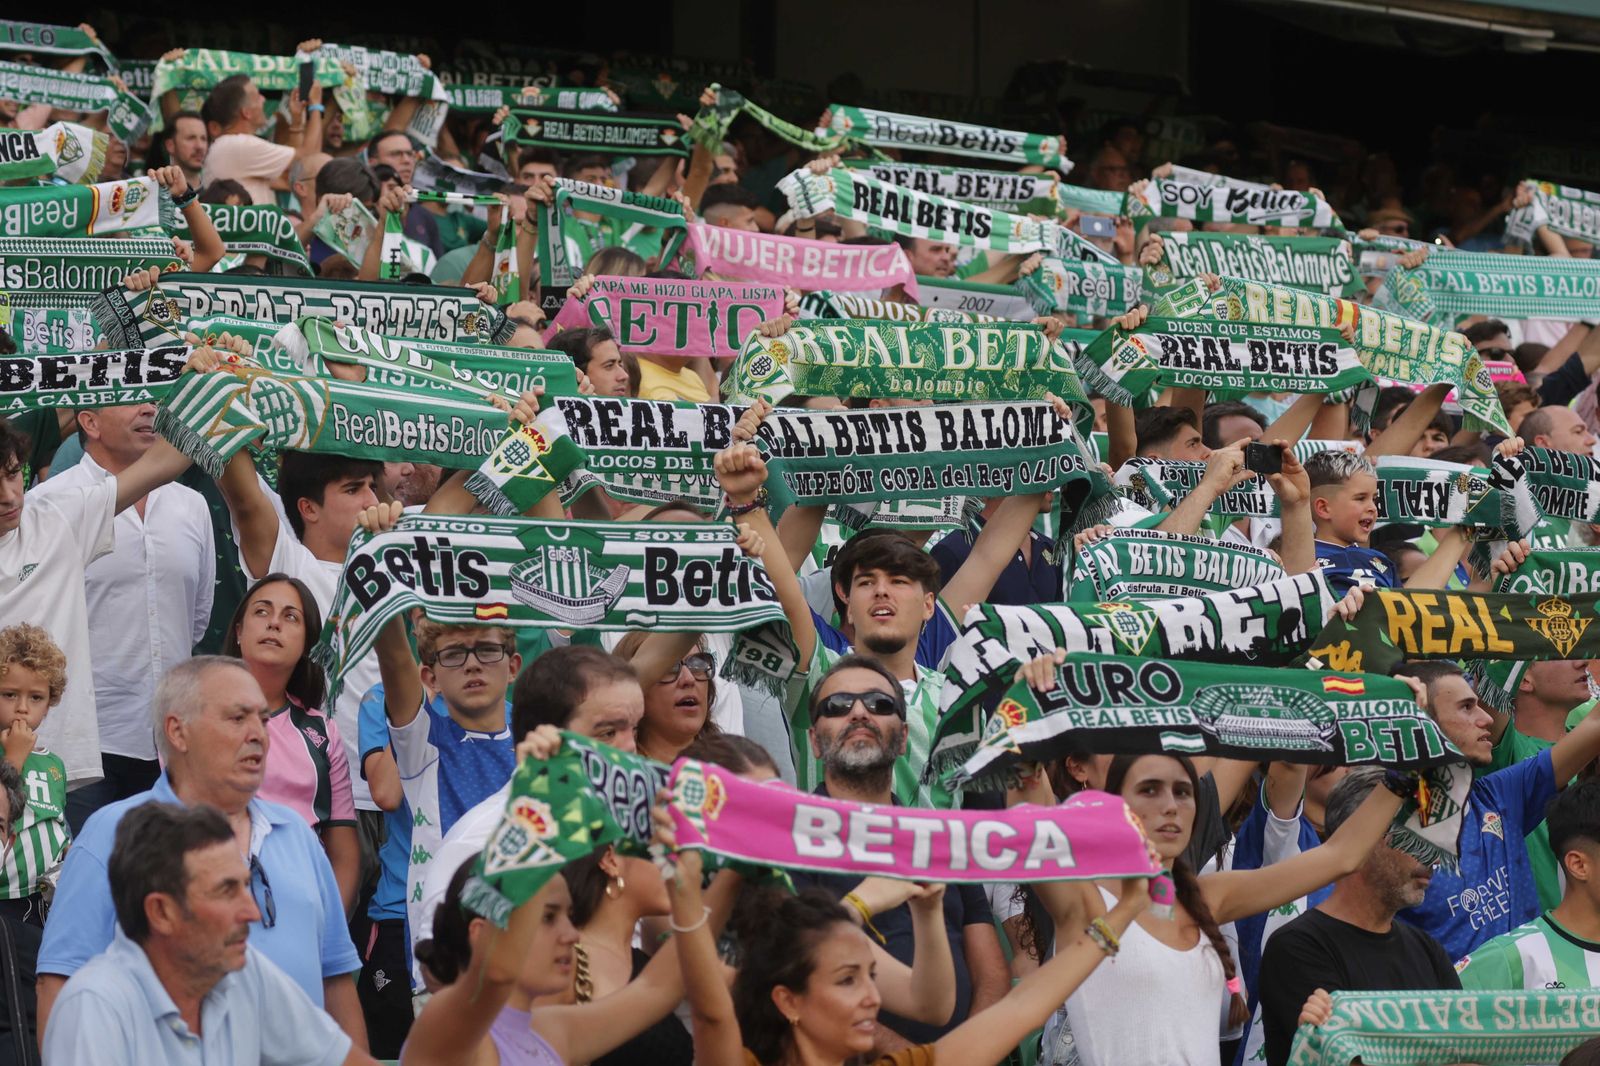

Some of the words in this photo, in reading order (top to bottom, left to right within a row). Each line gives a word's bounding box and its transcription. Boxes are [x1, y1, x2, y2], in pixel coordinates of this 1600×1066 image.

[544, 121, 570, 140] REAL
[573, 123, 603, 142] BETIS
[875, 115, 1018, 154] RealBetis
[955, 173, 1036, 200] BETIS
[1163, 183, 1213, 206] SOY
[630, 281, 649, 295] ME
[654, 284, 686, 297] HIZO
[743, 287, 778, 300] LISTA
[1067, 271, 1116, 301] Real
[1475, 272, 1537, 295] BETIS
[959, 295, 995, 313] 2007
[23, 311, 75, 348] Betis
[1167, 321, 1212, 333] DICEN
[1219, 323, 1248, 336] QUE
[1254, 325, 1321, 340] ESTAMOS
[1244, 282, 1331, 328] REAL
[1361, 309, 1466, 367] BETIS
[511, 352, 531, 360] BETIS
[788, 325, 925, 370] REAL
[1158, 334, 1242, 372] REAL
[1248, 339, 1339, 376] BETIS
[0, 346, 188, 392] BETIS
[1174, 373, 1223, 387] LOCOS
[1228, 376, 1246, 387] DE
[1250, 377, 1268, 388] LA
[1271, 378, 1329, 390] CABEZA
[37, 388, 154, 407] CABEZA
[557, 398, 691, 450] REAL
[758, 416, 828, 463] EAL
[825, 411, 927, 457] BETIS
[589, 453, 657, 470] LOCOS
[663, 456, 695, 471] DE
[702, 457, 715, 471] L
[1159, 465, 1190, 487] Rey
[881, 467, 938, 492] COPA
[941, 463, 972, 489] del
[976, 463, 1014, 492] Rey
[1221, 493, 1267, 514] FINAL
[1391, 479, 1451, 519] REAL
[394, 517, 486, 533] ÉTICO
[633, 530, 686, 542] SOY
[695, 527, 735, 542] BÉ
[345, 536, 490, 613] Betis
[1128, 542, 1189, 578] BETIS
[645, 546, 777, 607] Betis
[1168, 585, 1179, 595] El
[1377, 590, 1515, 655] REAL
[1030, 661, 1184, 715] EURO
[1068, 705, 1129, 729] REAL
[1133, 705, 1192, 727] BETIS
[793, 803, 1076, 870] BÉTICA
[1494, 994, 1600, 1032] BETIS
